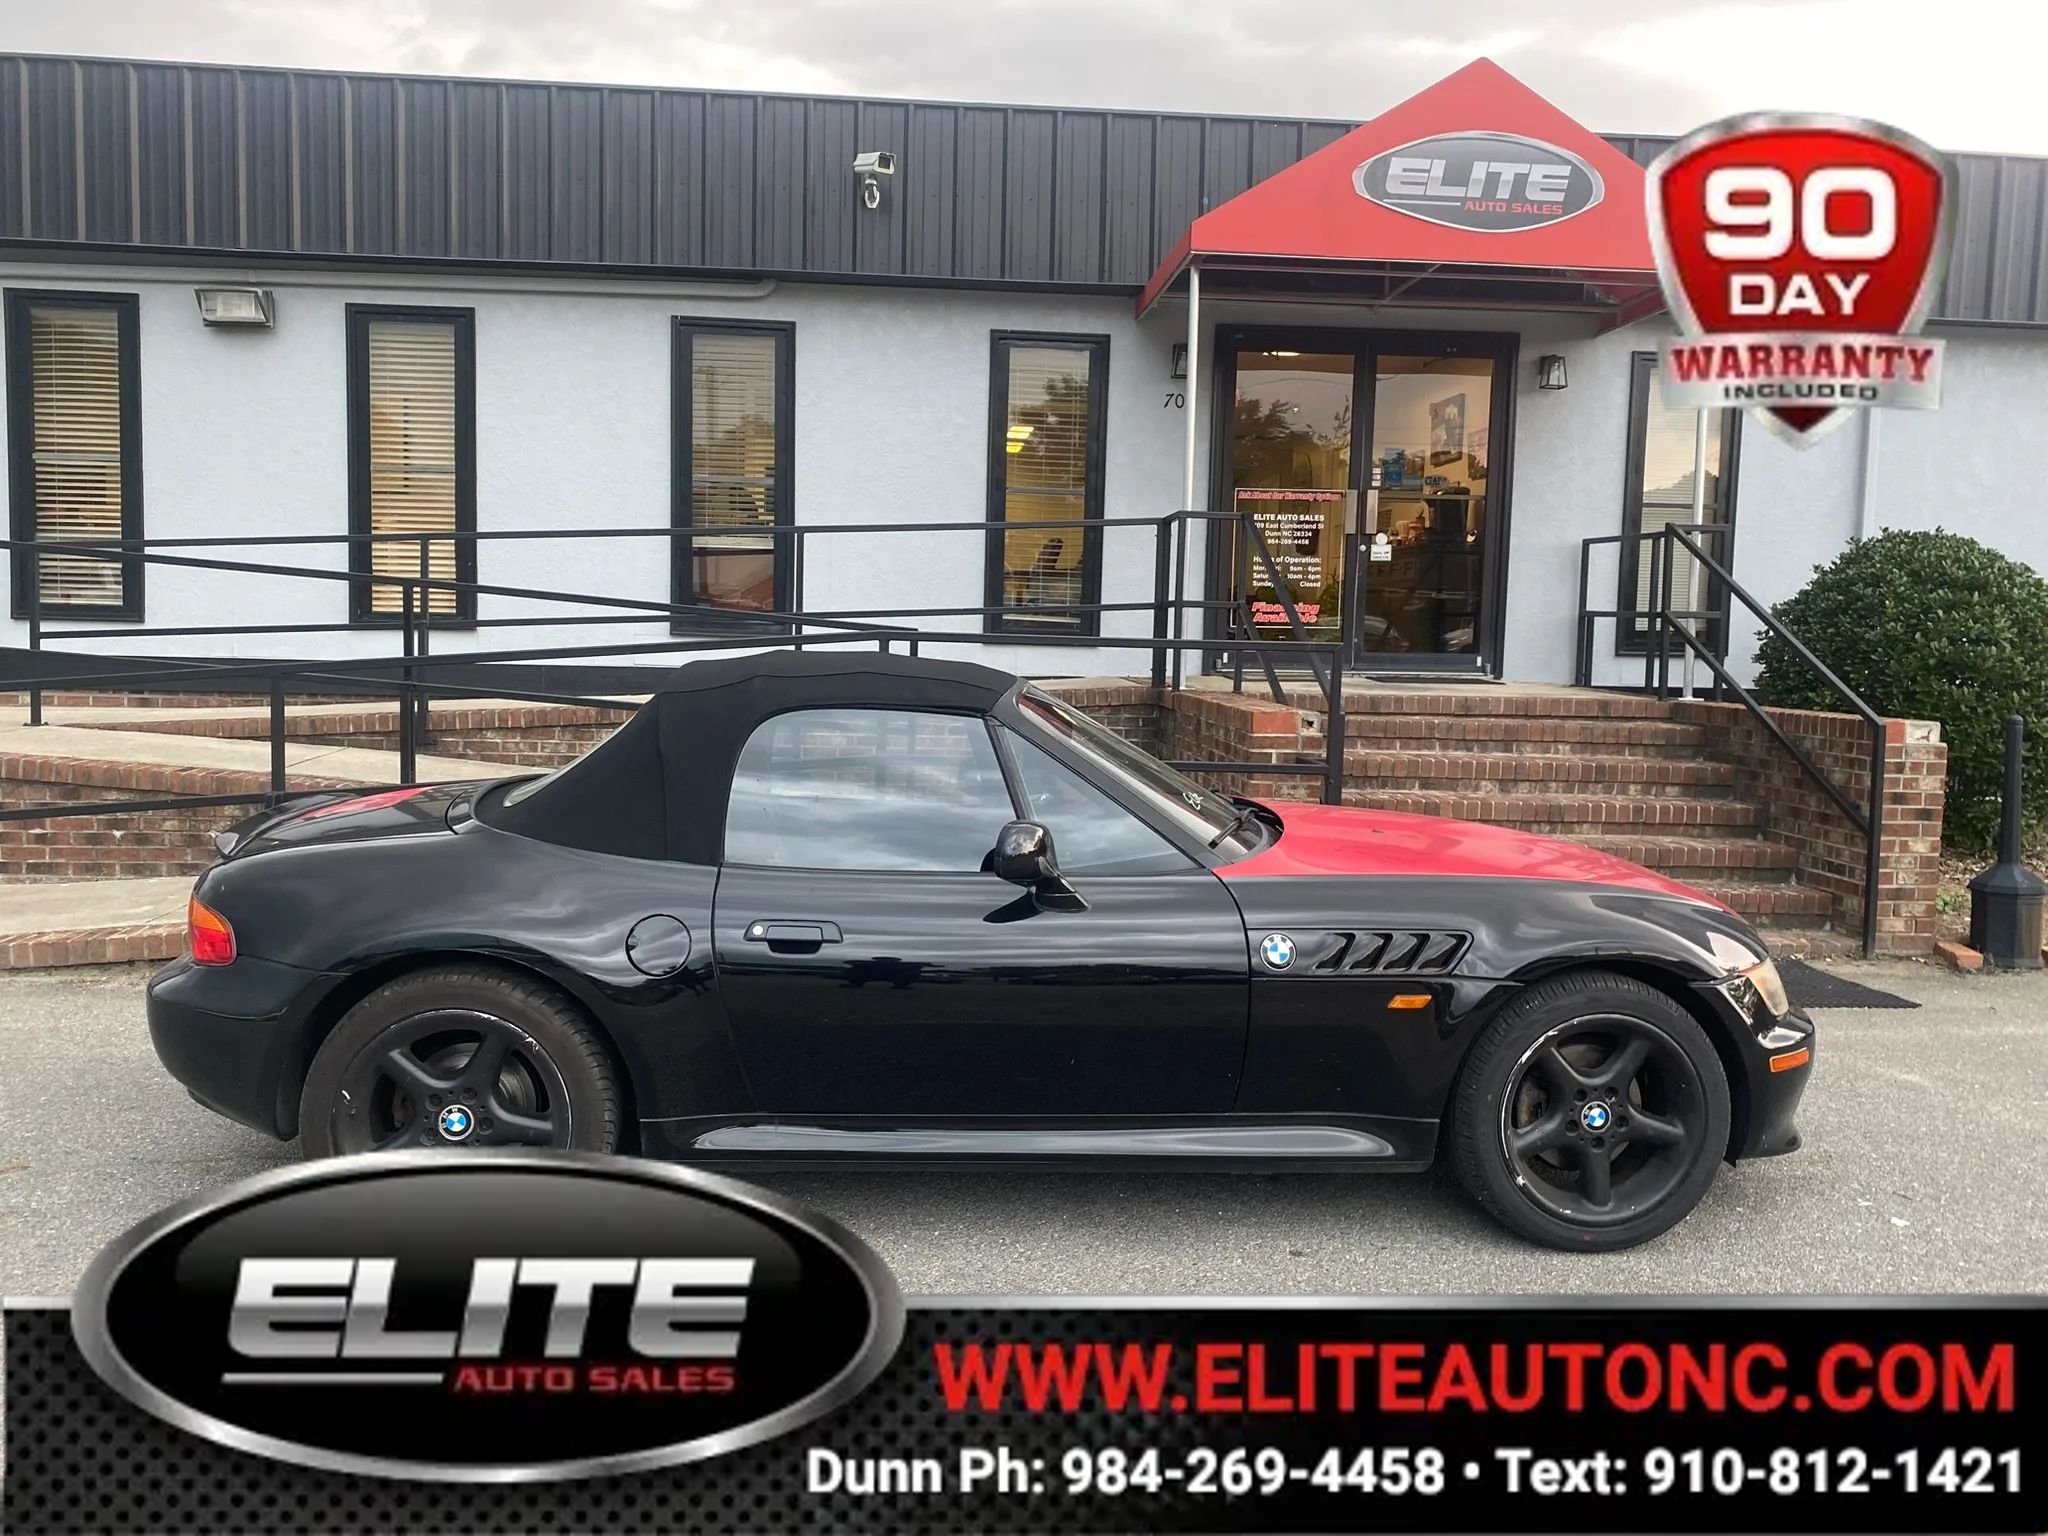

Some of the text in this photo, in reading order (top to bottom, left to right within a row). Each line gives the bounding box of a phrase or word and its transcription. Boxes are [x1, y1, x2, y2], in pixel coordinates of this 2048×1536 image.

[1385, 157, 1571, 202] ELITE
[1464, 200, 1563, 214] AUTO SALES
[1253, 513, 1276, 521] ELITE
[1299, 514, 1325, 522] SALES
[1279, 522, 1317, 530] Cumberland
[1284, 556, 1322, 564] Operation:
